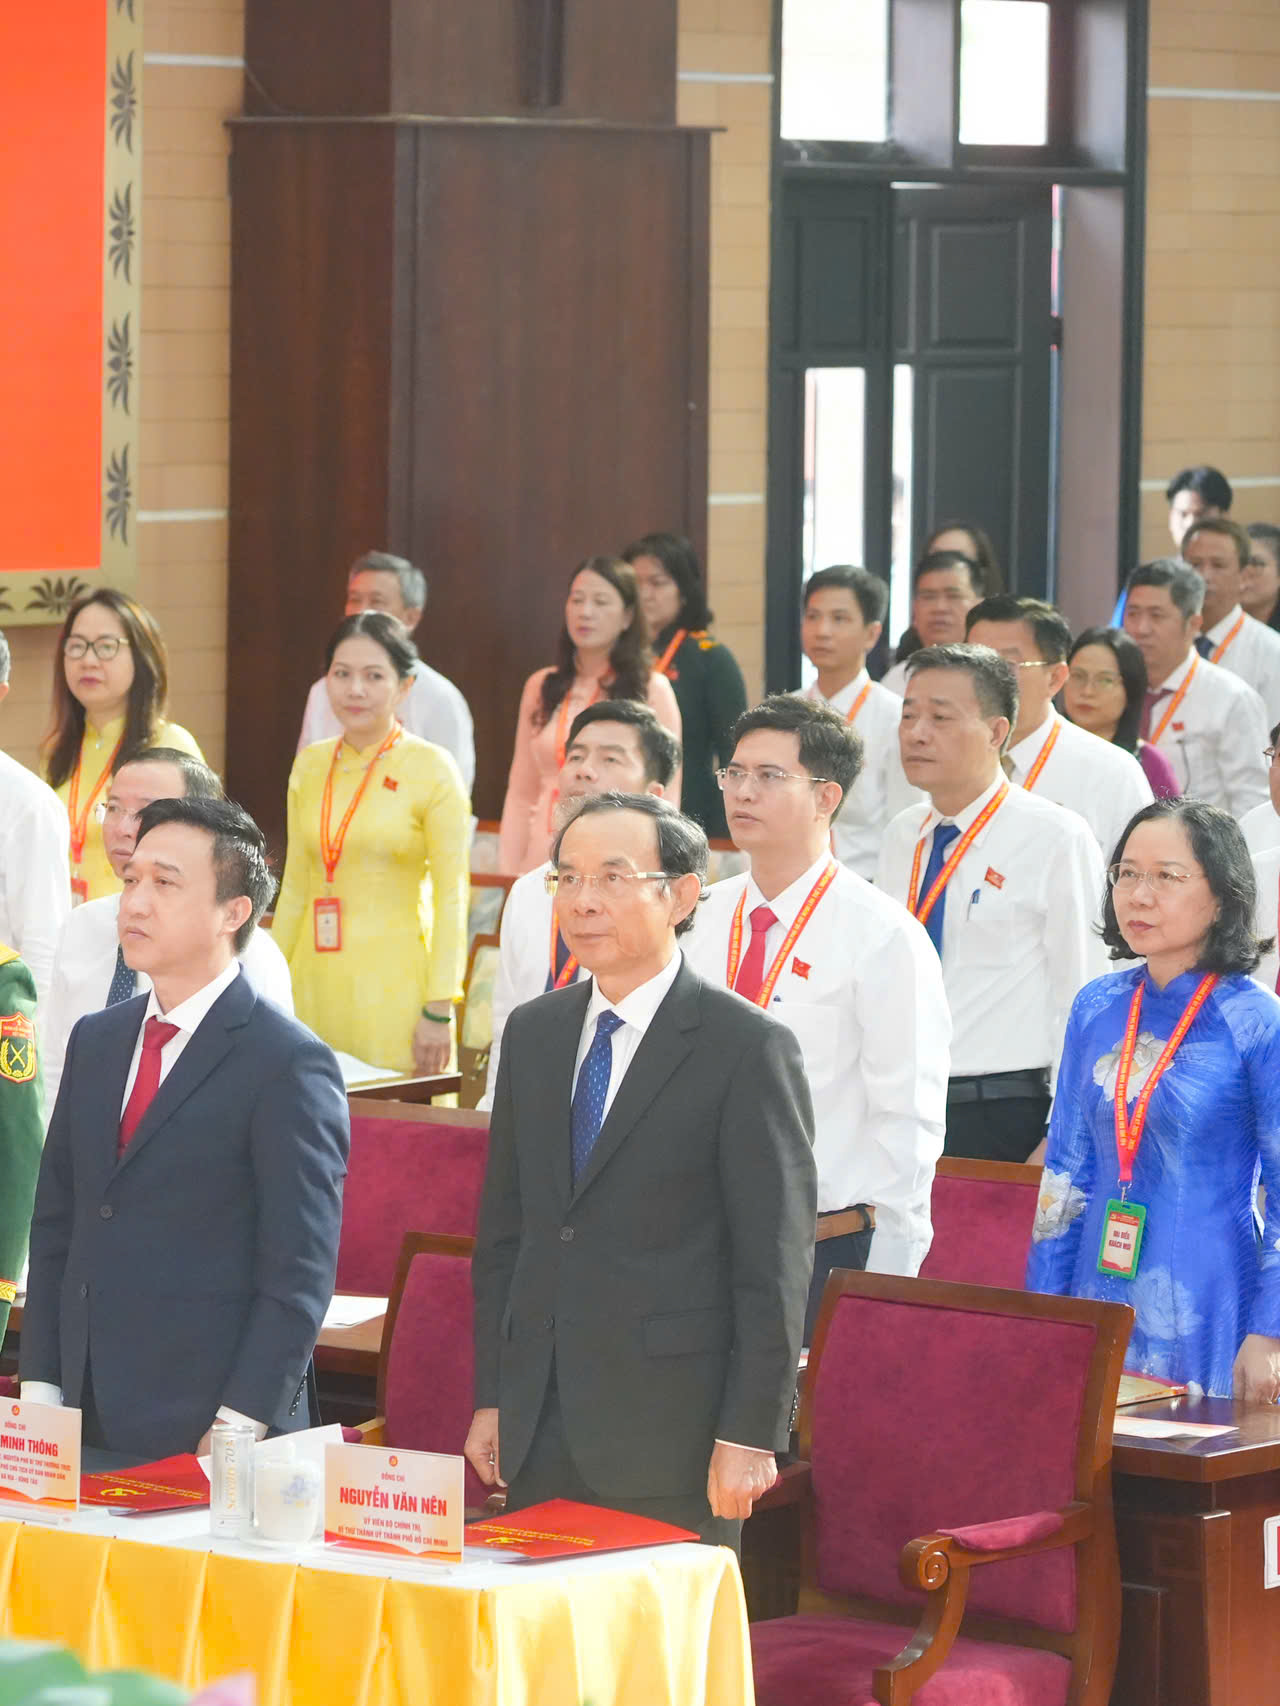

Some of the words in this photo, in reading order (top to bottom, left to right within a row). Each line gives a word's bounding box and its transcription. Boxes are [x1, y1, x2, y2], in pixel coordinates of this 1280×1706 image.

[1, 1435, 24, 1451] MINH
[28, 1439, 58, 1456] THÔNG
[340, 1486, 389, 1509] NGUYỄN
[393, 1492, 417, 1512] VĂN
[421, 1496, 447, 1516] NÊN
